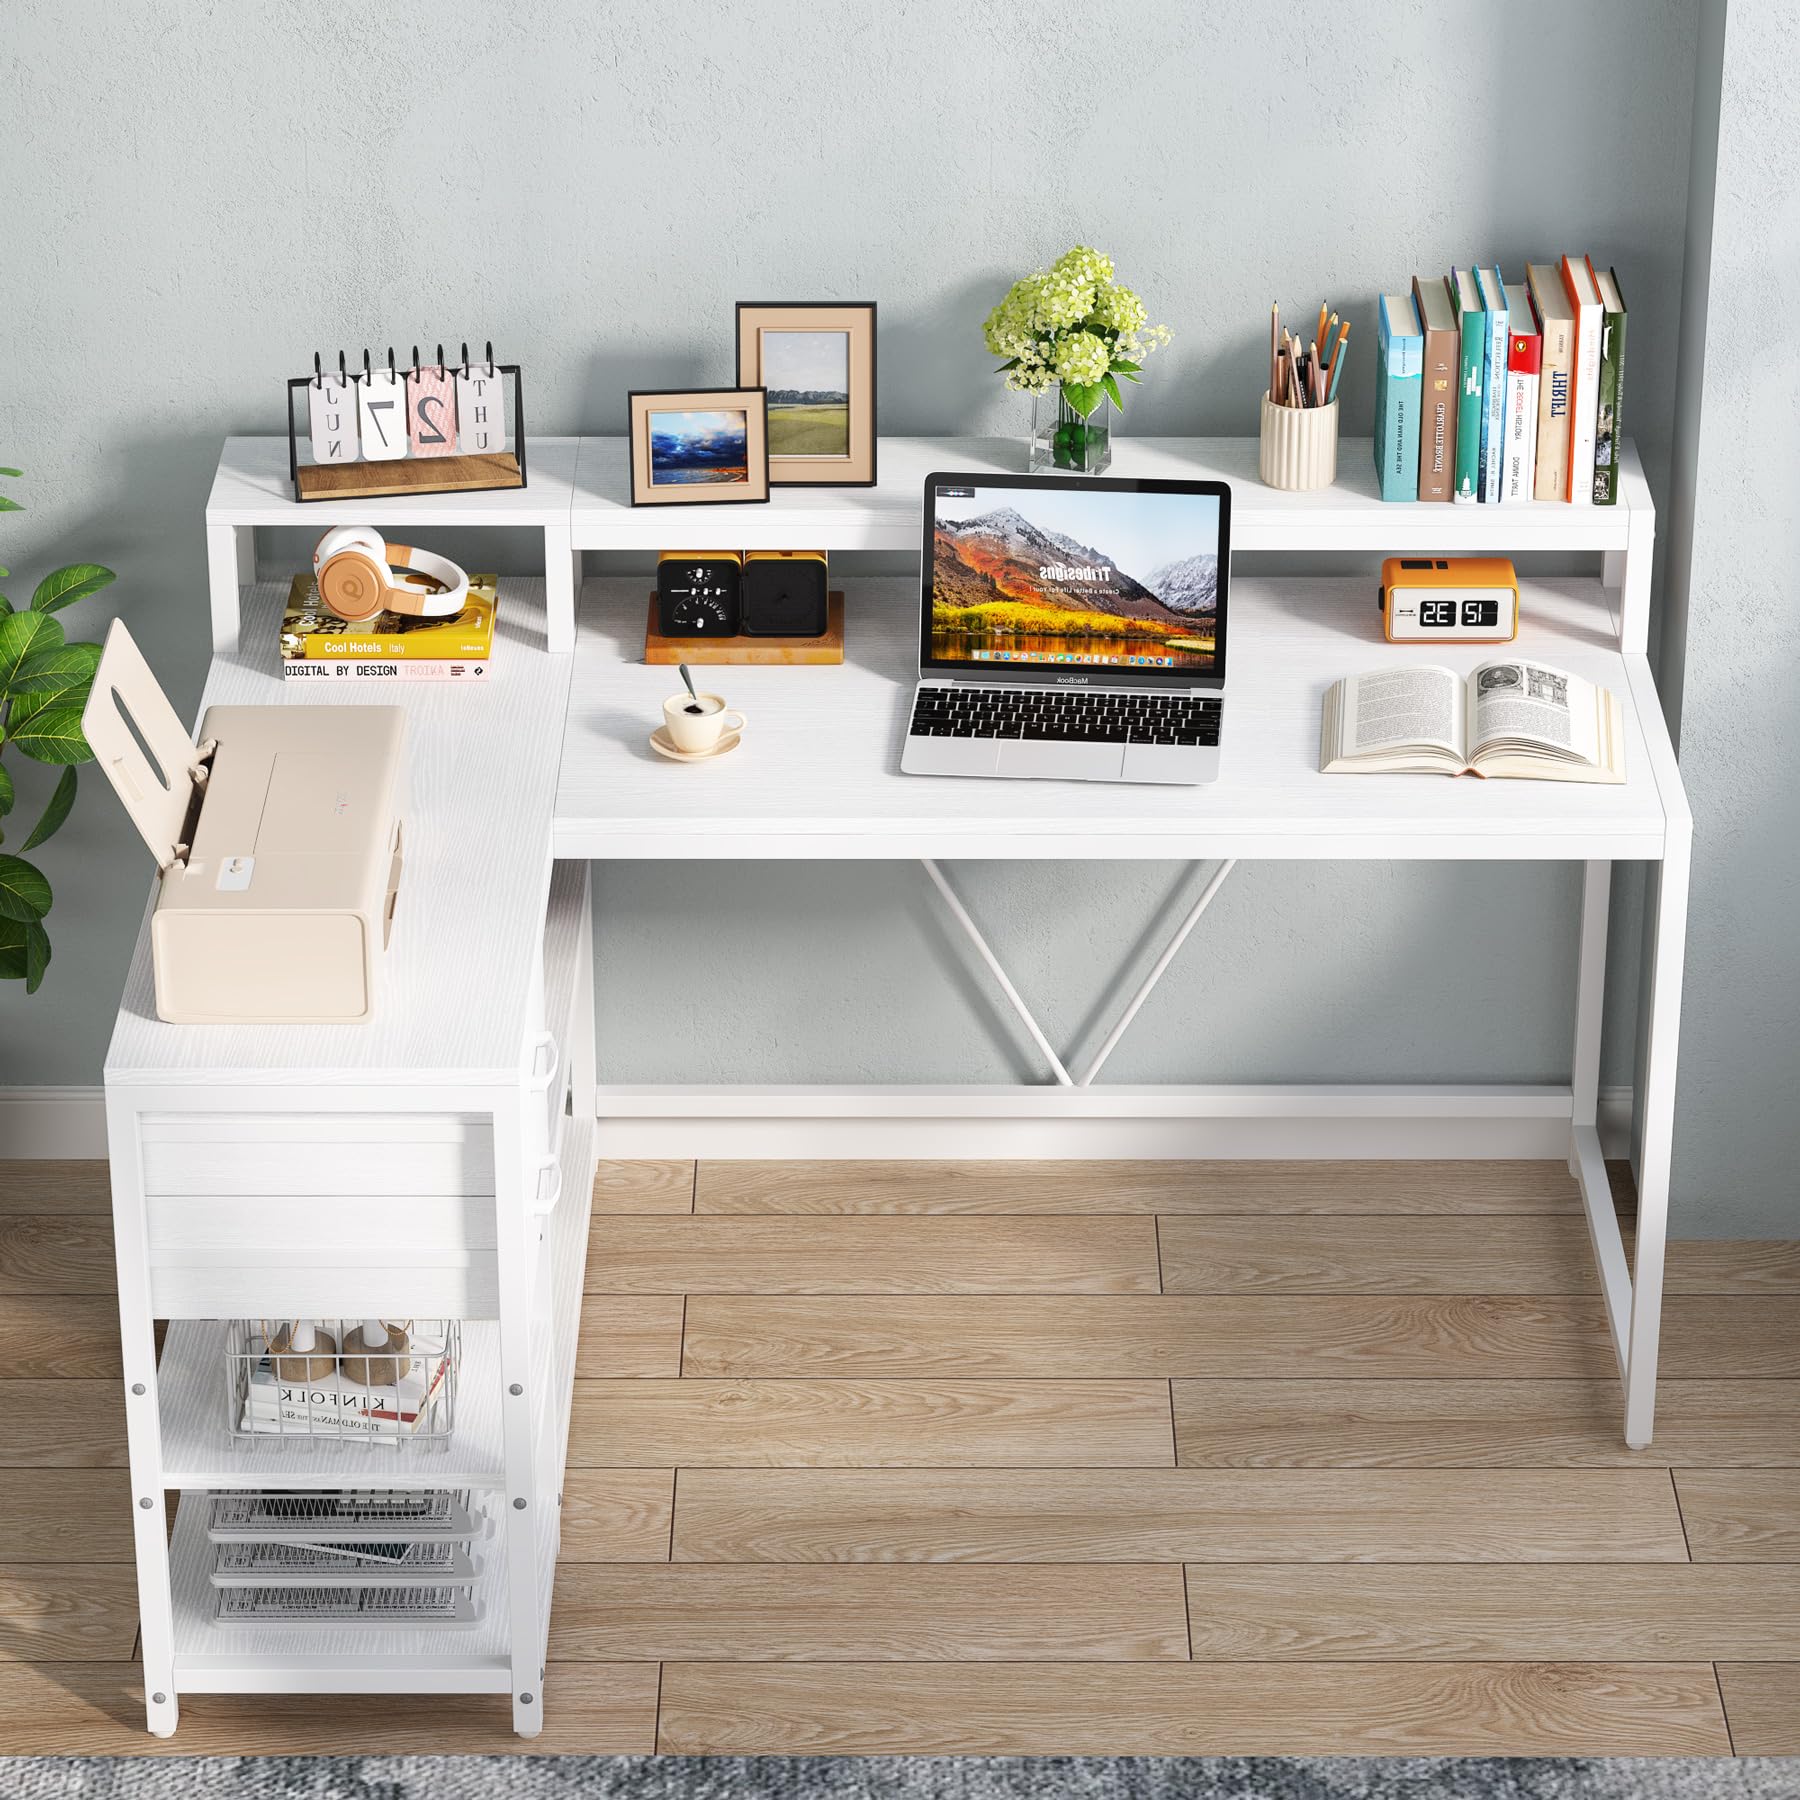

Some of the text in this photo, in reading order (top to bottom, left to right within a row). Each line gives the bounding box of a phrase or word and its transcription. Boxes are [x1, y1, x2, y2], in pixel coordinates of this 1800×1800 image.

[298, 608, 317, 626] Cool
[324, 642, 405, 655] Cool Hotels Italy
[285, 665, 330, 676] DIGITAL
[336, 665, 349, 676] BY
[356, 665, 397, 676] DESIGN
[404, 665, 445, 676] TROIKA
